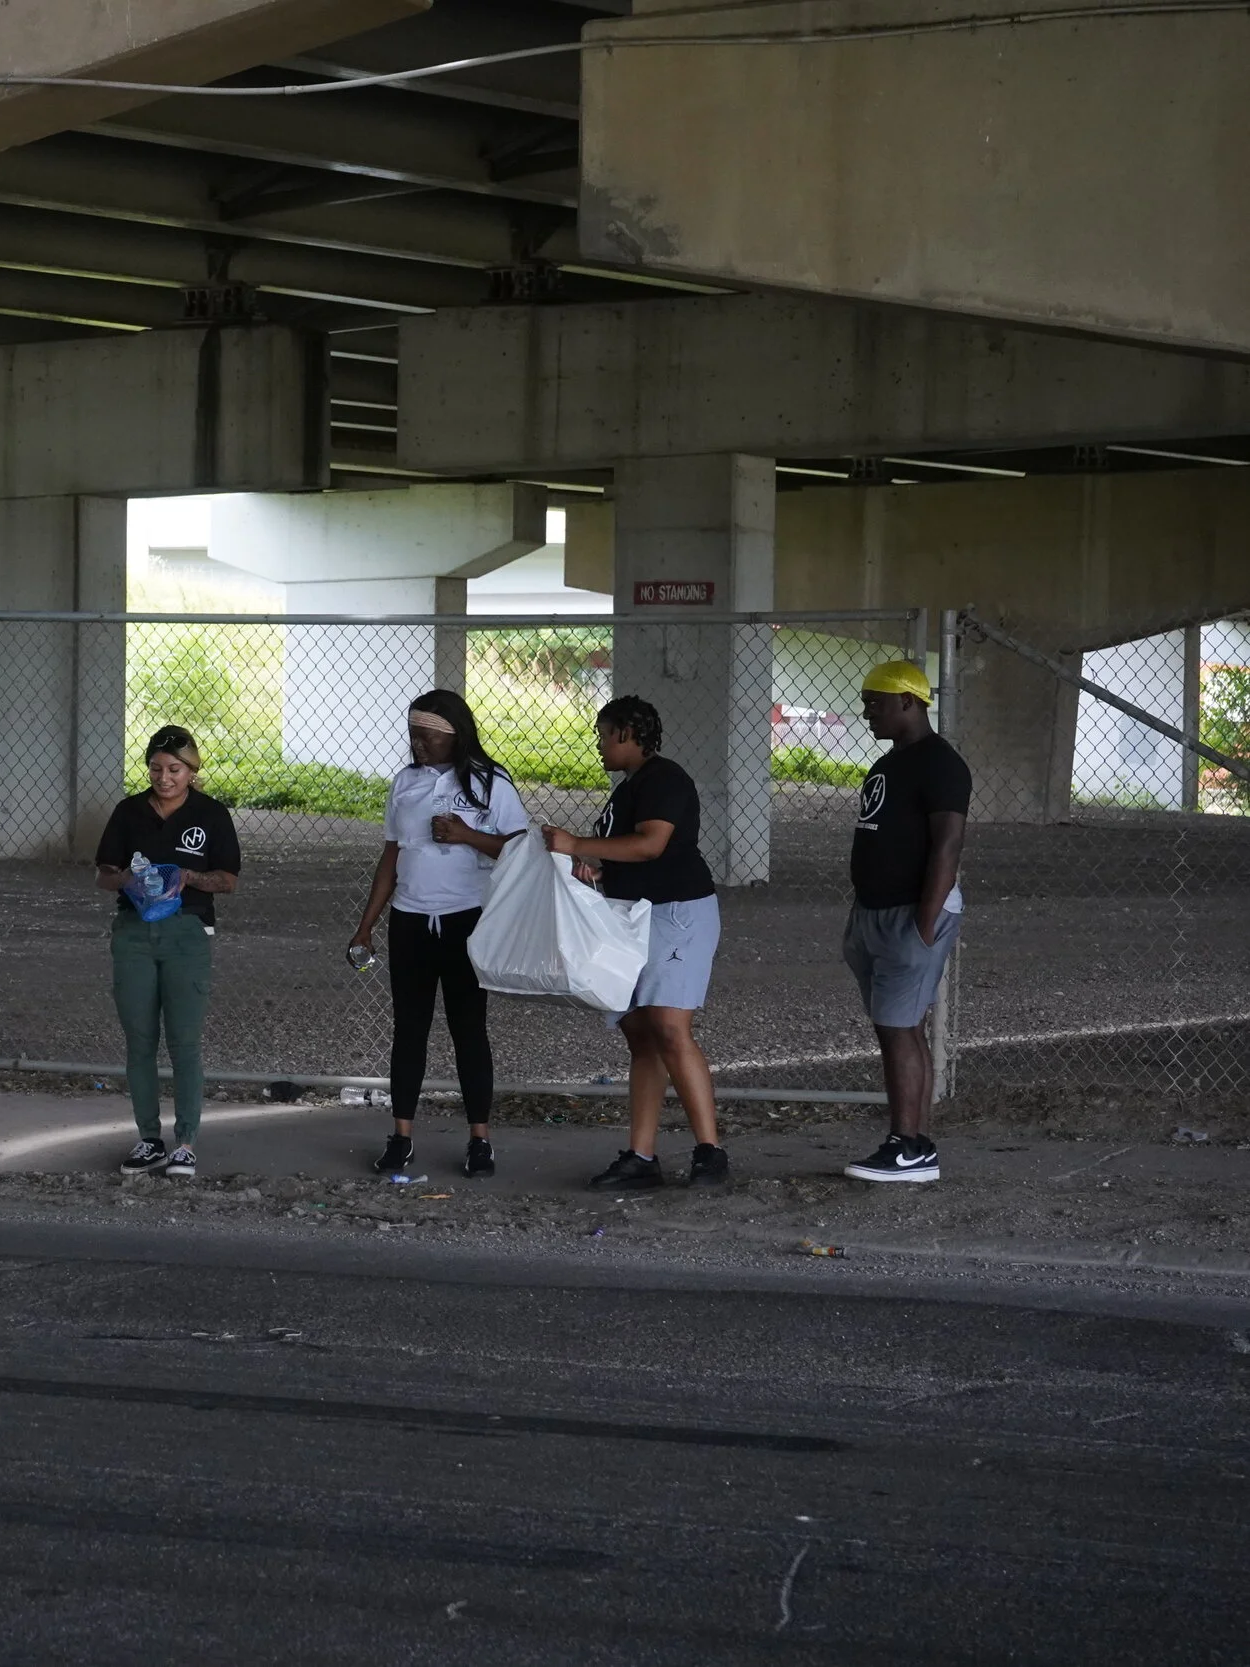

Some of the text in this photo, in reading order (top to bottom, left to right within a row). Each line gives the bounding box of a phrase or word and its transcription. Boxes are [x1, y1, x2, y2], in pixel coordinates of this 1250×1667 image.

[640, 584, 707, 600] NO STANDING
[183, 827, 204, 848] NH
